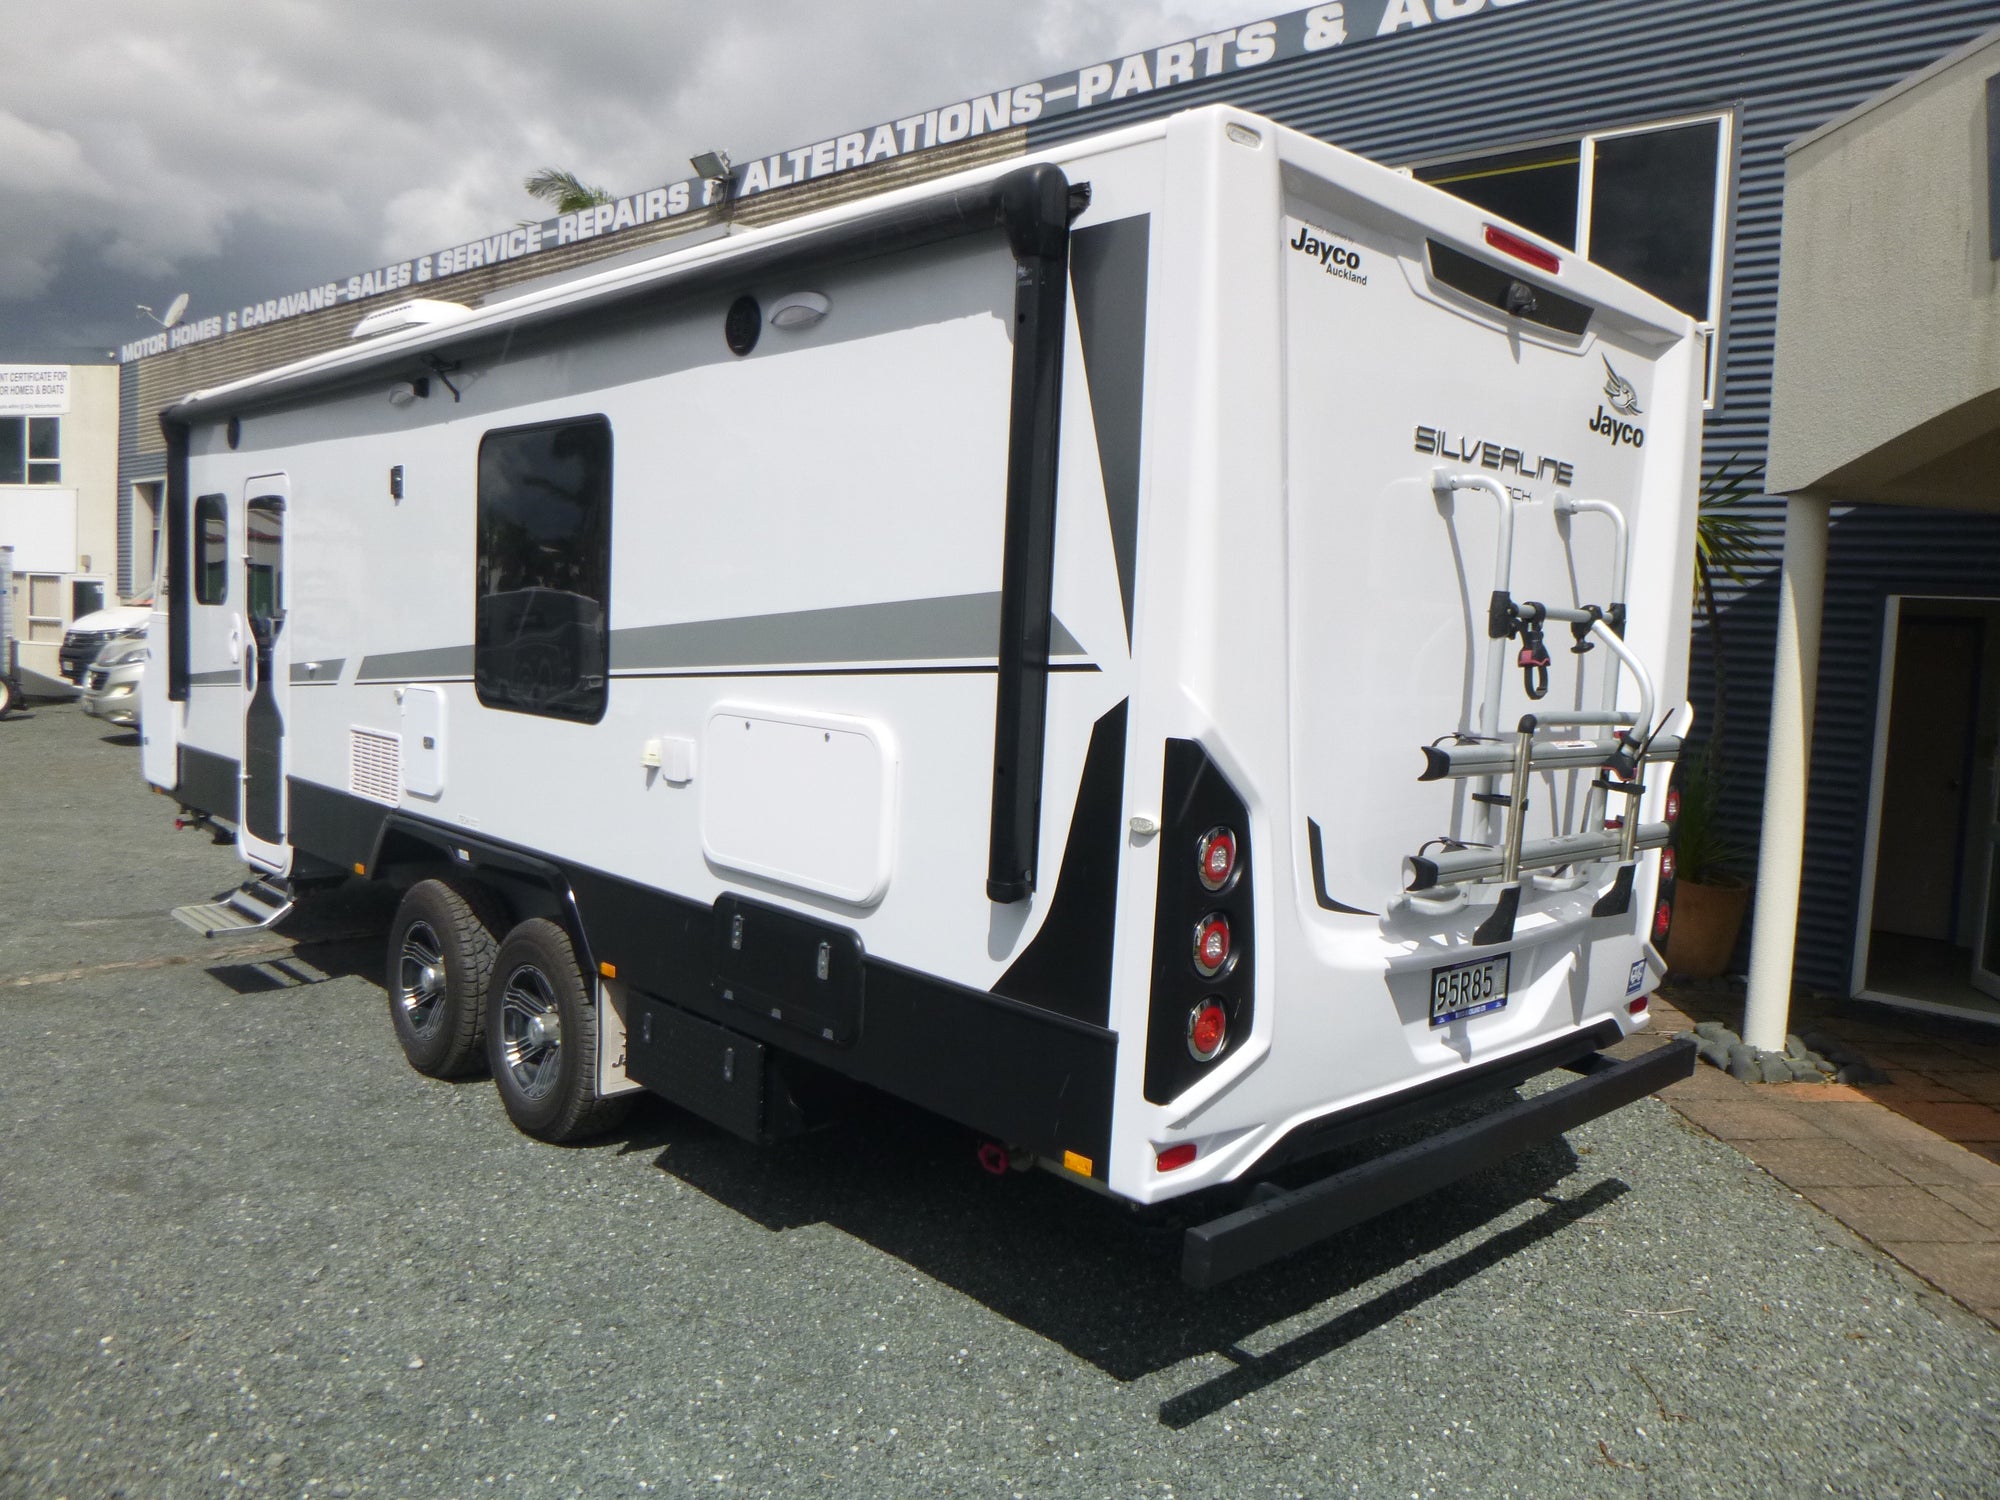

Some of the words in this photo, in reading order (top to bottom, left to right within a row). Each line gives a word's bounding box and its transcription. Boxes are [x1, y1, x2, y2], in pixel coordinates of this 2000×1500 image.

[122, 332, 168, 363] MOTOR
[171, 316, 222, 348] HOMES
[226, 311, 238, 333] &
[418, 256, 432, 282] &
[1303, 2, 1349, 53] &
[1290, 227, 1361, 270] Jayco
[1326, 263, 1368, 286] Auckland
[10, 371, 52, 382] CERTIFICATE
[53, 371, 68, 381] FOR
[10, 385, 34, 395] HOMES
[35, 384, 41, 395] &
[42, 384, 64, 395] BOATS
[1589, 404, 1644, 448] Jayco
[1414, 425, 1574, 487] SILVERLINE
[1436, 966, 1493, 1011] 95R85
